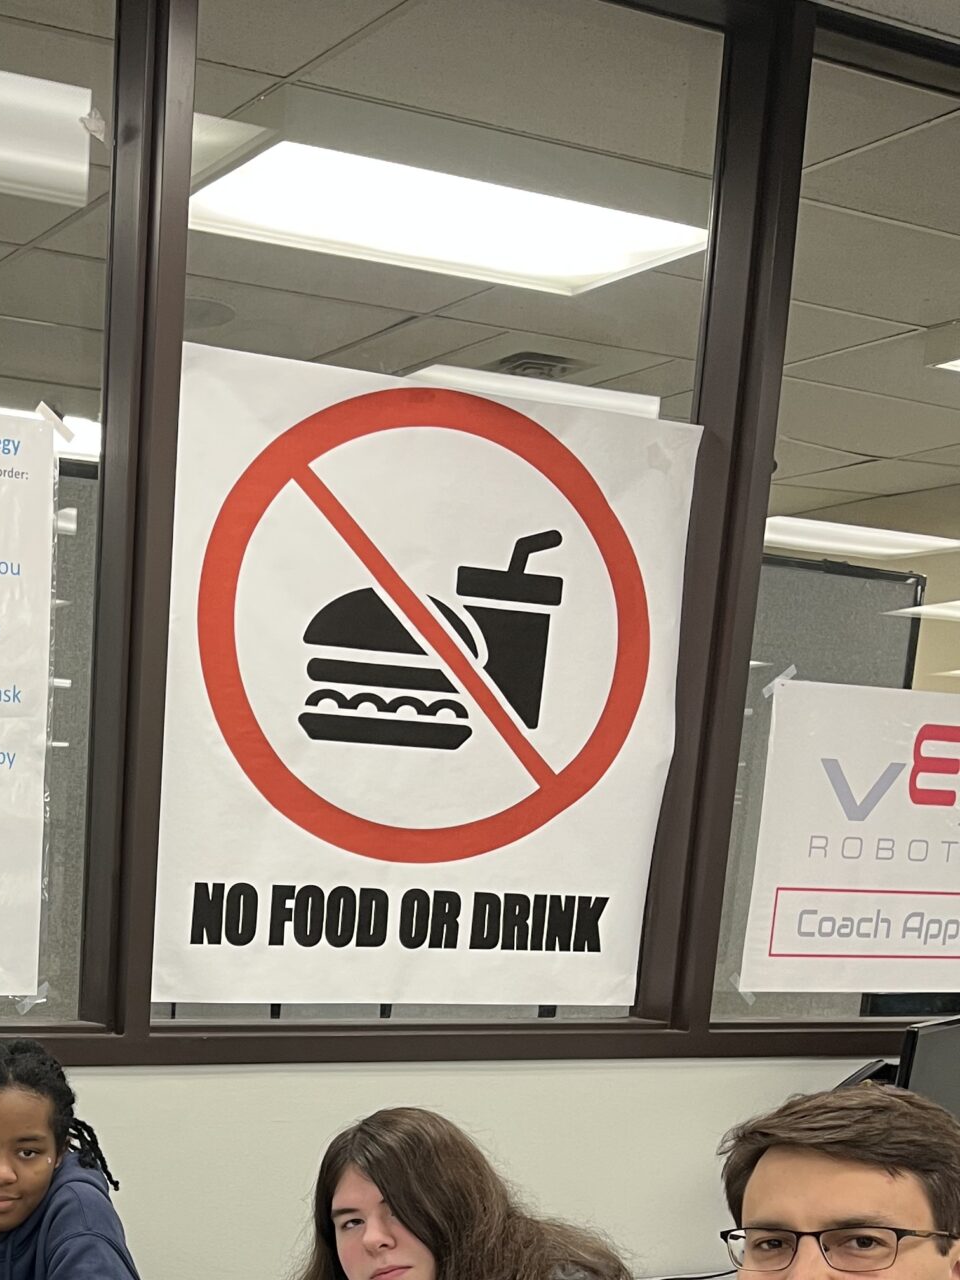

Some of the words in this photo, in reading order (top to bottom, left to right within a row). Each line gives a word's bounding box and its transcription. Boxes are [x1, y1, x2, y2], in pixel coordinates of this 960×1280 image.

[821, 723, 960, 822] VE
[189, 882, 258, 946] NO
[268, 884, 390, 949] FOOD
[398, 888, 462, 950] OR
[468, 891, 610, 953] DRINK
[797, 909, 891, 939] Coach
[901, 912, 960, 946] App
